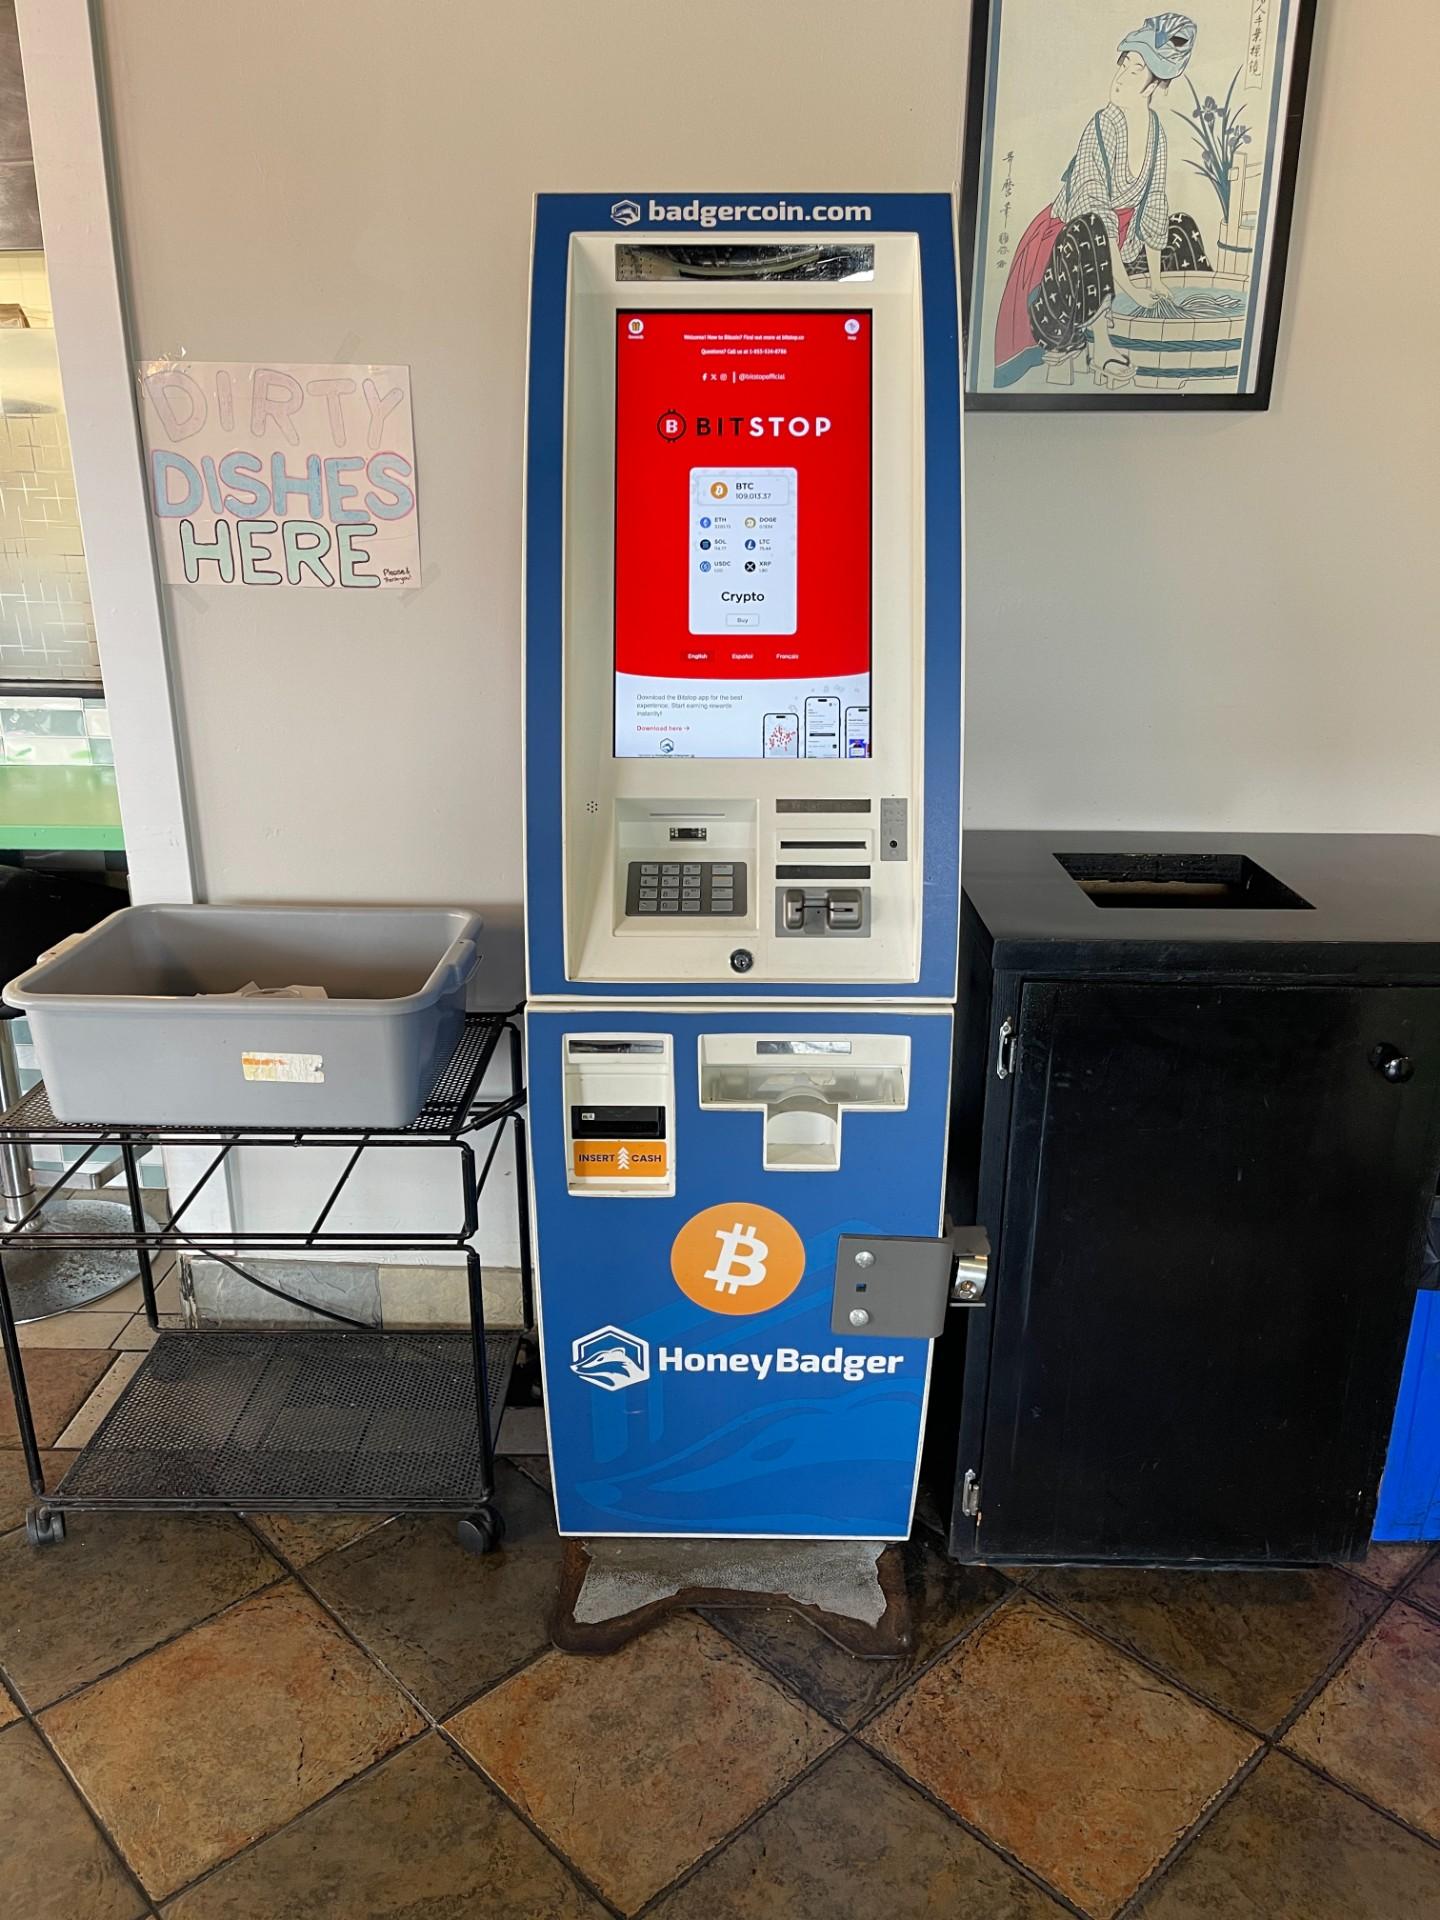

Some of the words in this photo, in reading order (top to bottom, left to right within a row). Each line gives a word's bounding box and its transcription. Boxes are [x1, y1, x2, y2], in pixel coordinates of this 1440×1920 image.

[648, 200, 872, 228] badgercoin.com
[144, 368, 404, 450] DIRTY
[696, 416, 832, 437] BITSTOP
[151, 450, 415, 523] DISHES
[180, 519, 381, 588] HERE
[721, 591, 765, 603] Crypto
[698, 694, 709, 702] app
[578, 1153, 615, 1163] INSERT
[631, 1153, 662, 1163] CASH
[658, 1347, 904, 1381] HoneyBadger
